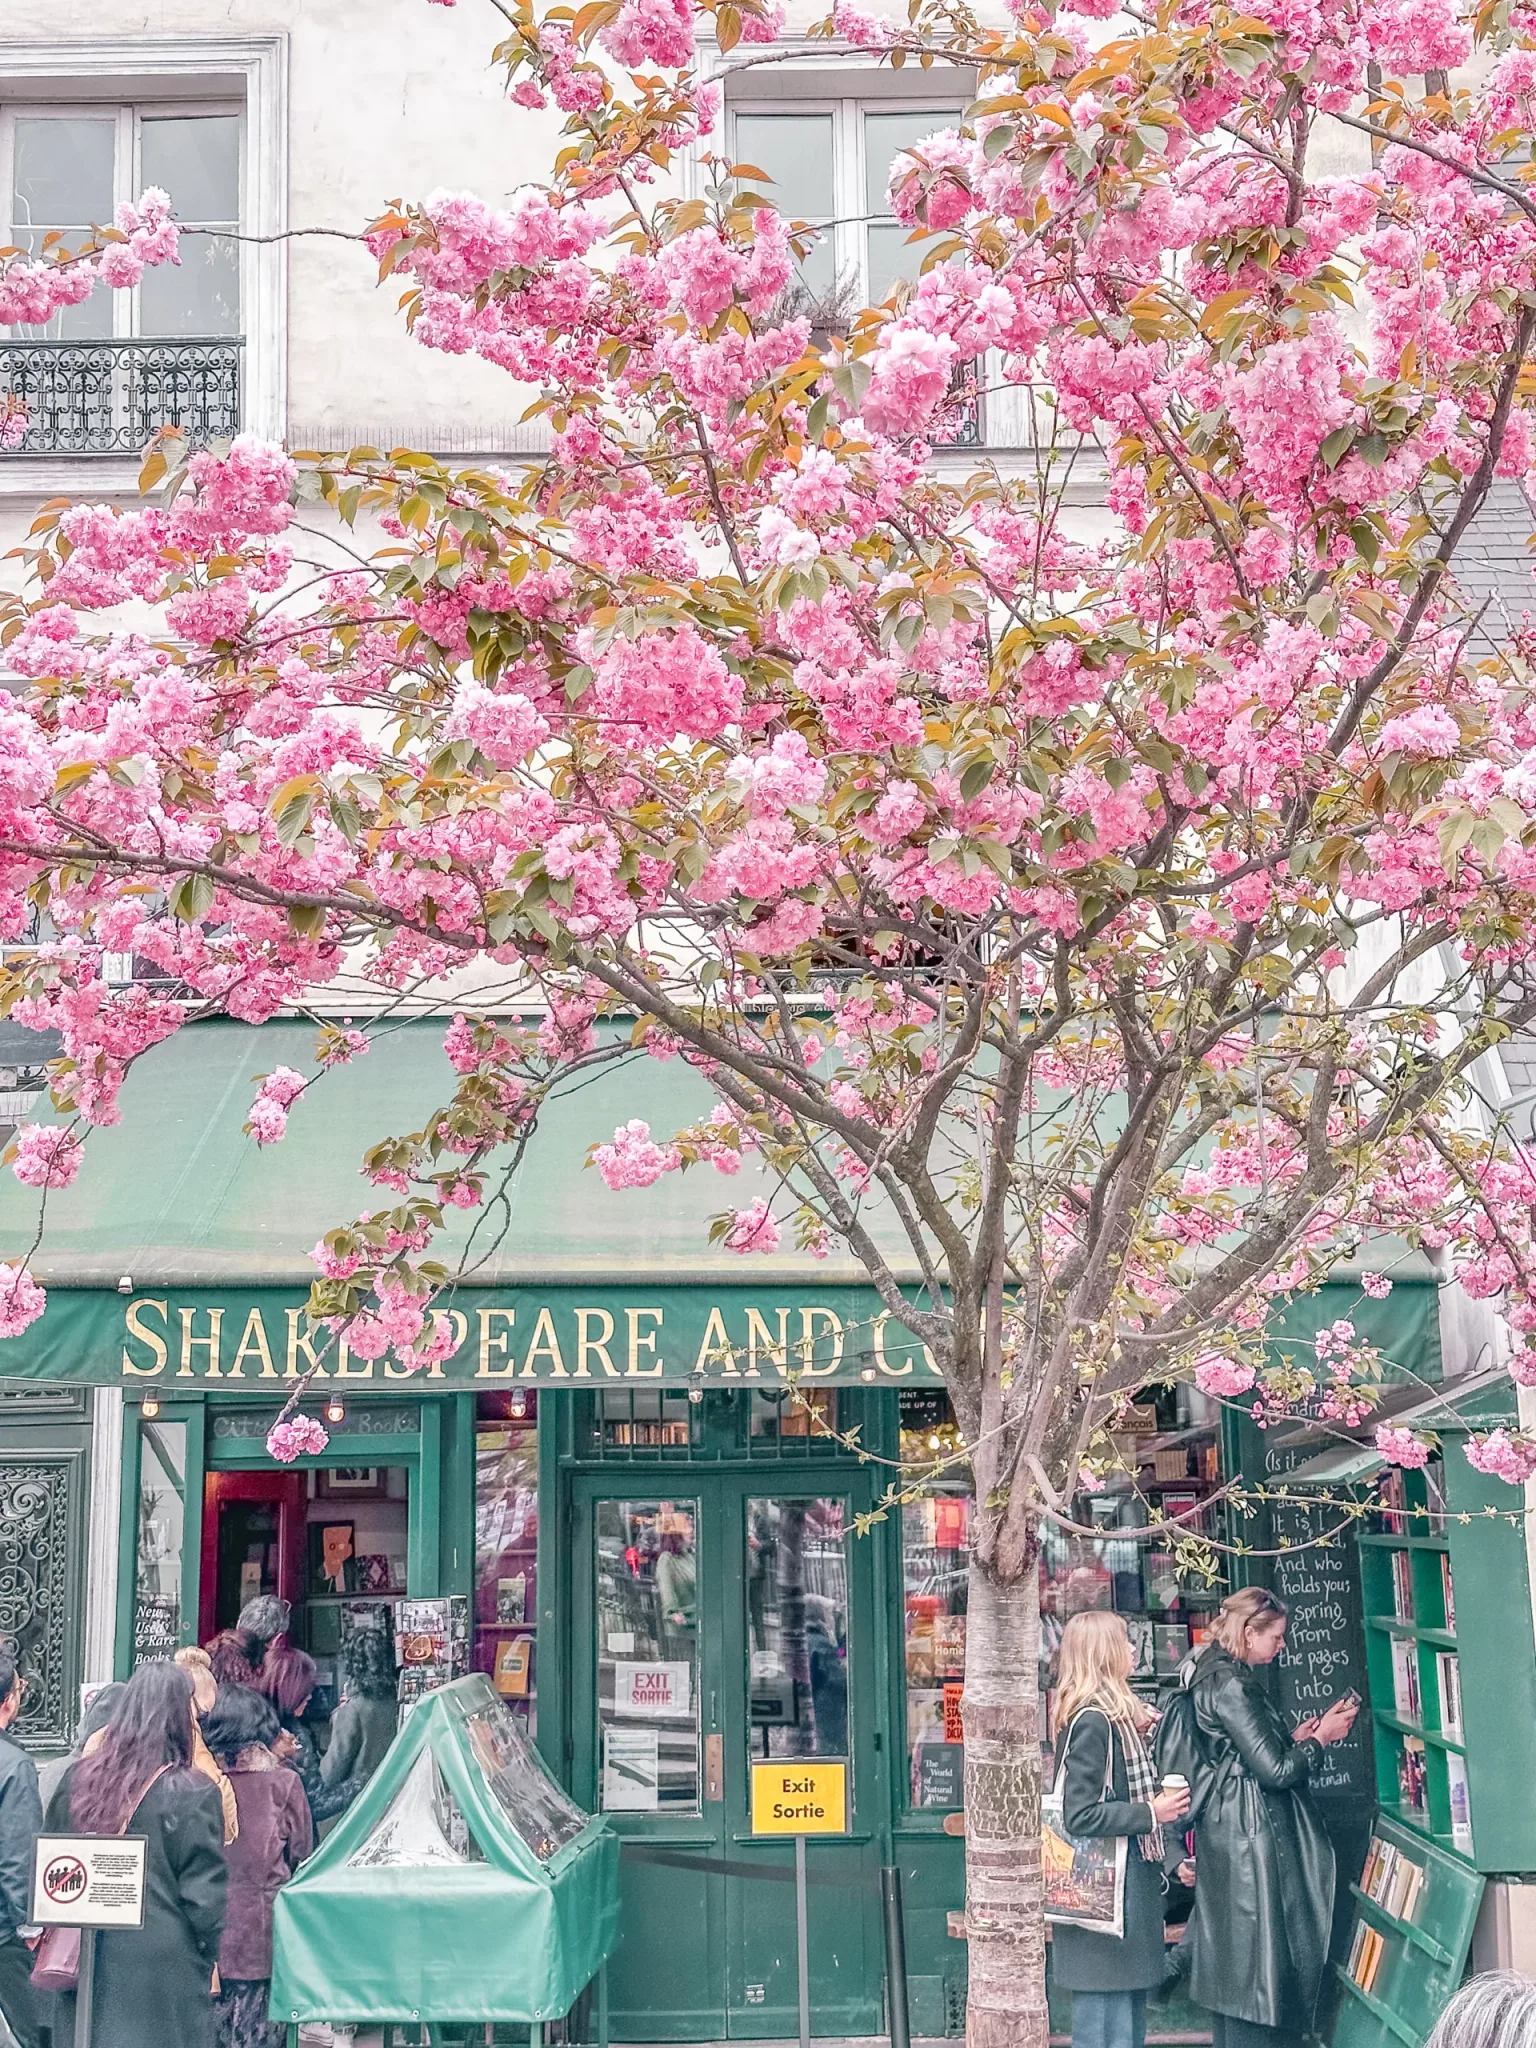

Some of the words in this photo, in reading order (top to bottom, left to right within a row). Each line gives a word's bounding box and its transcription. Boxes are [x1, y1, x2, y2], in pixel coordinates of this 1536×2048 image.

[122, 1299, 664, 1378] SHAKPEARE
[696, 1306, 843, 1377] AND
[1272, 1513, 1285, 1533] It
[1295, 1513, 1310, 1530] is
[1274, 1553, 1308, 1573] And
[1315, 1552, 1343, 1570] who
[1282, 1574, 1320, 1595] holds
[1323, 1580, 1350, 1602] you;
[1295, 1602, 1347, 1629] spring
[135, 1634, 145, 1647] &
[148, 1634, 176, 1647] Rare
[1289, 1621, 1332, 1649] from
[1278, 1646, 1303, 1668] the
[1308, 1648, 1350, 1676] pages
[635, 1672, 669, 1689] EXIT
[1294, 1675, 1333, 1700] into
[632, 1690, 673, 1705] SORTIE
[924, 1759, 939, 1768] The
[930, 1767, 953, 1777] World
[782, 1777, 816, 1793] Exit
[923, 1775, 932, 1785] of
[924, 1785, 953, 1794] Natural
[773, 1802, 825, 1818] Sortie
